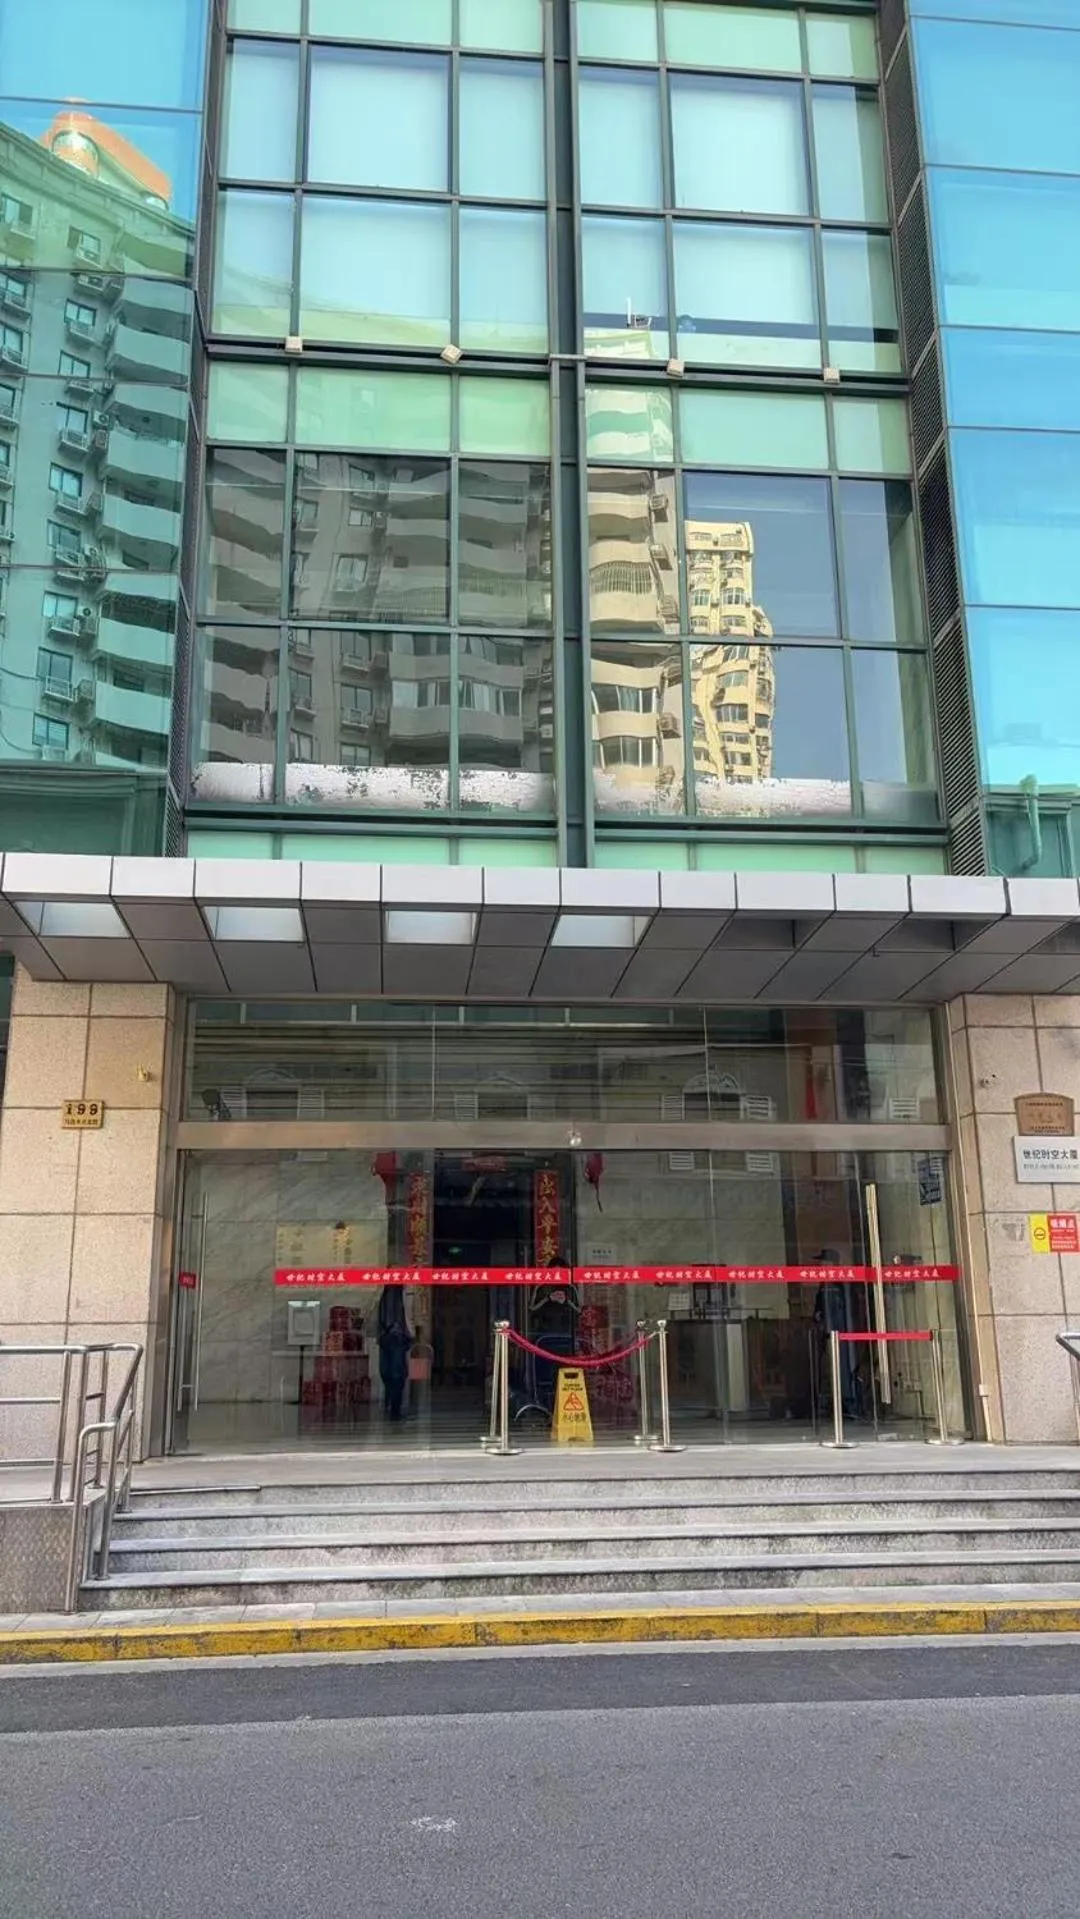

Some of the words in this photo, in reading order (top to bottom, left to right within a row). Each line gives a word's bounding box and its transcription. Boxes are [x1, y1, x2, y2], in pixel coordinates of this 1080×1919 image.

[66, 1103, 98, 1116] 199
[1023, 1148, 1078, 1160] 世纪时空大厦
